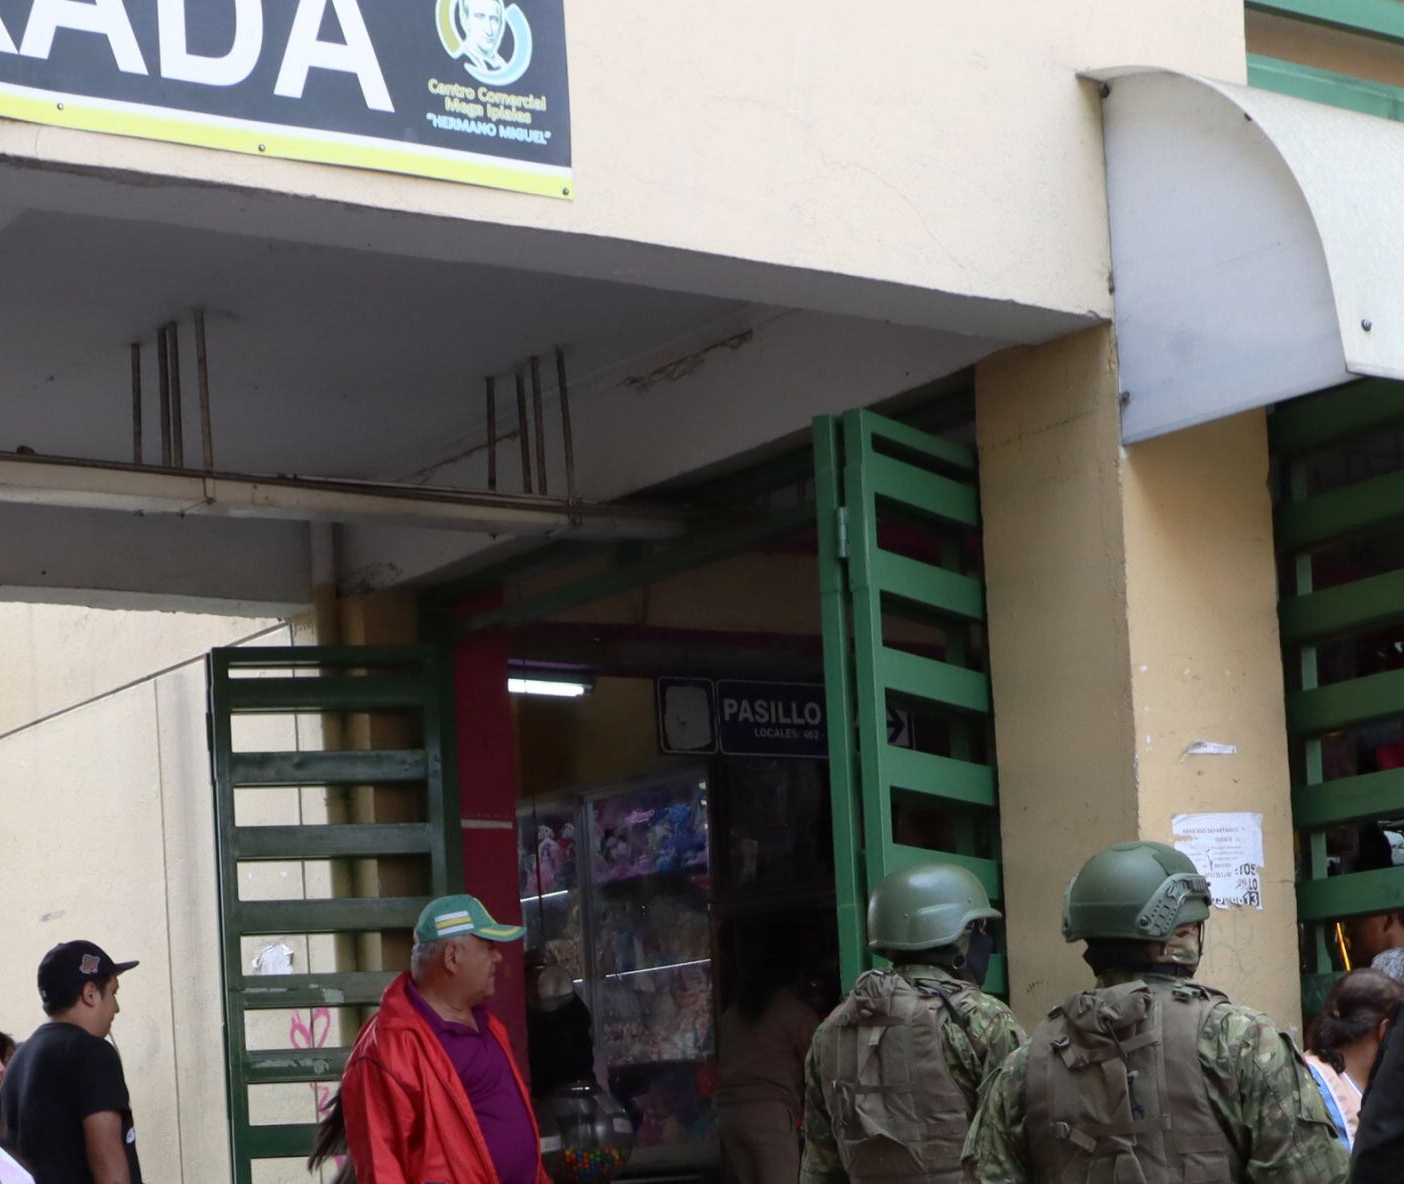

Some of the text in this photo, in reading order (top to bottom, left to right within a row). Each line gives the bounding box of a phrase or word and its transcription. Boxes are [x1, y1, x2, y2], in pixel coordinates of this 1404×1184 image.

[427, 78, 547, 111] Centro Comercial
[444, 97, 532, 124] Mega Ipiales
[723, 698, 821, 725] PASILLO
